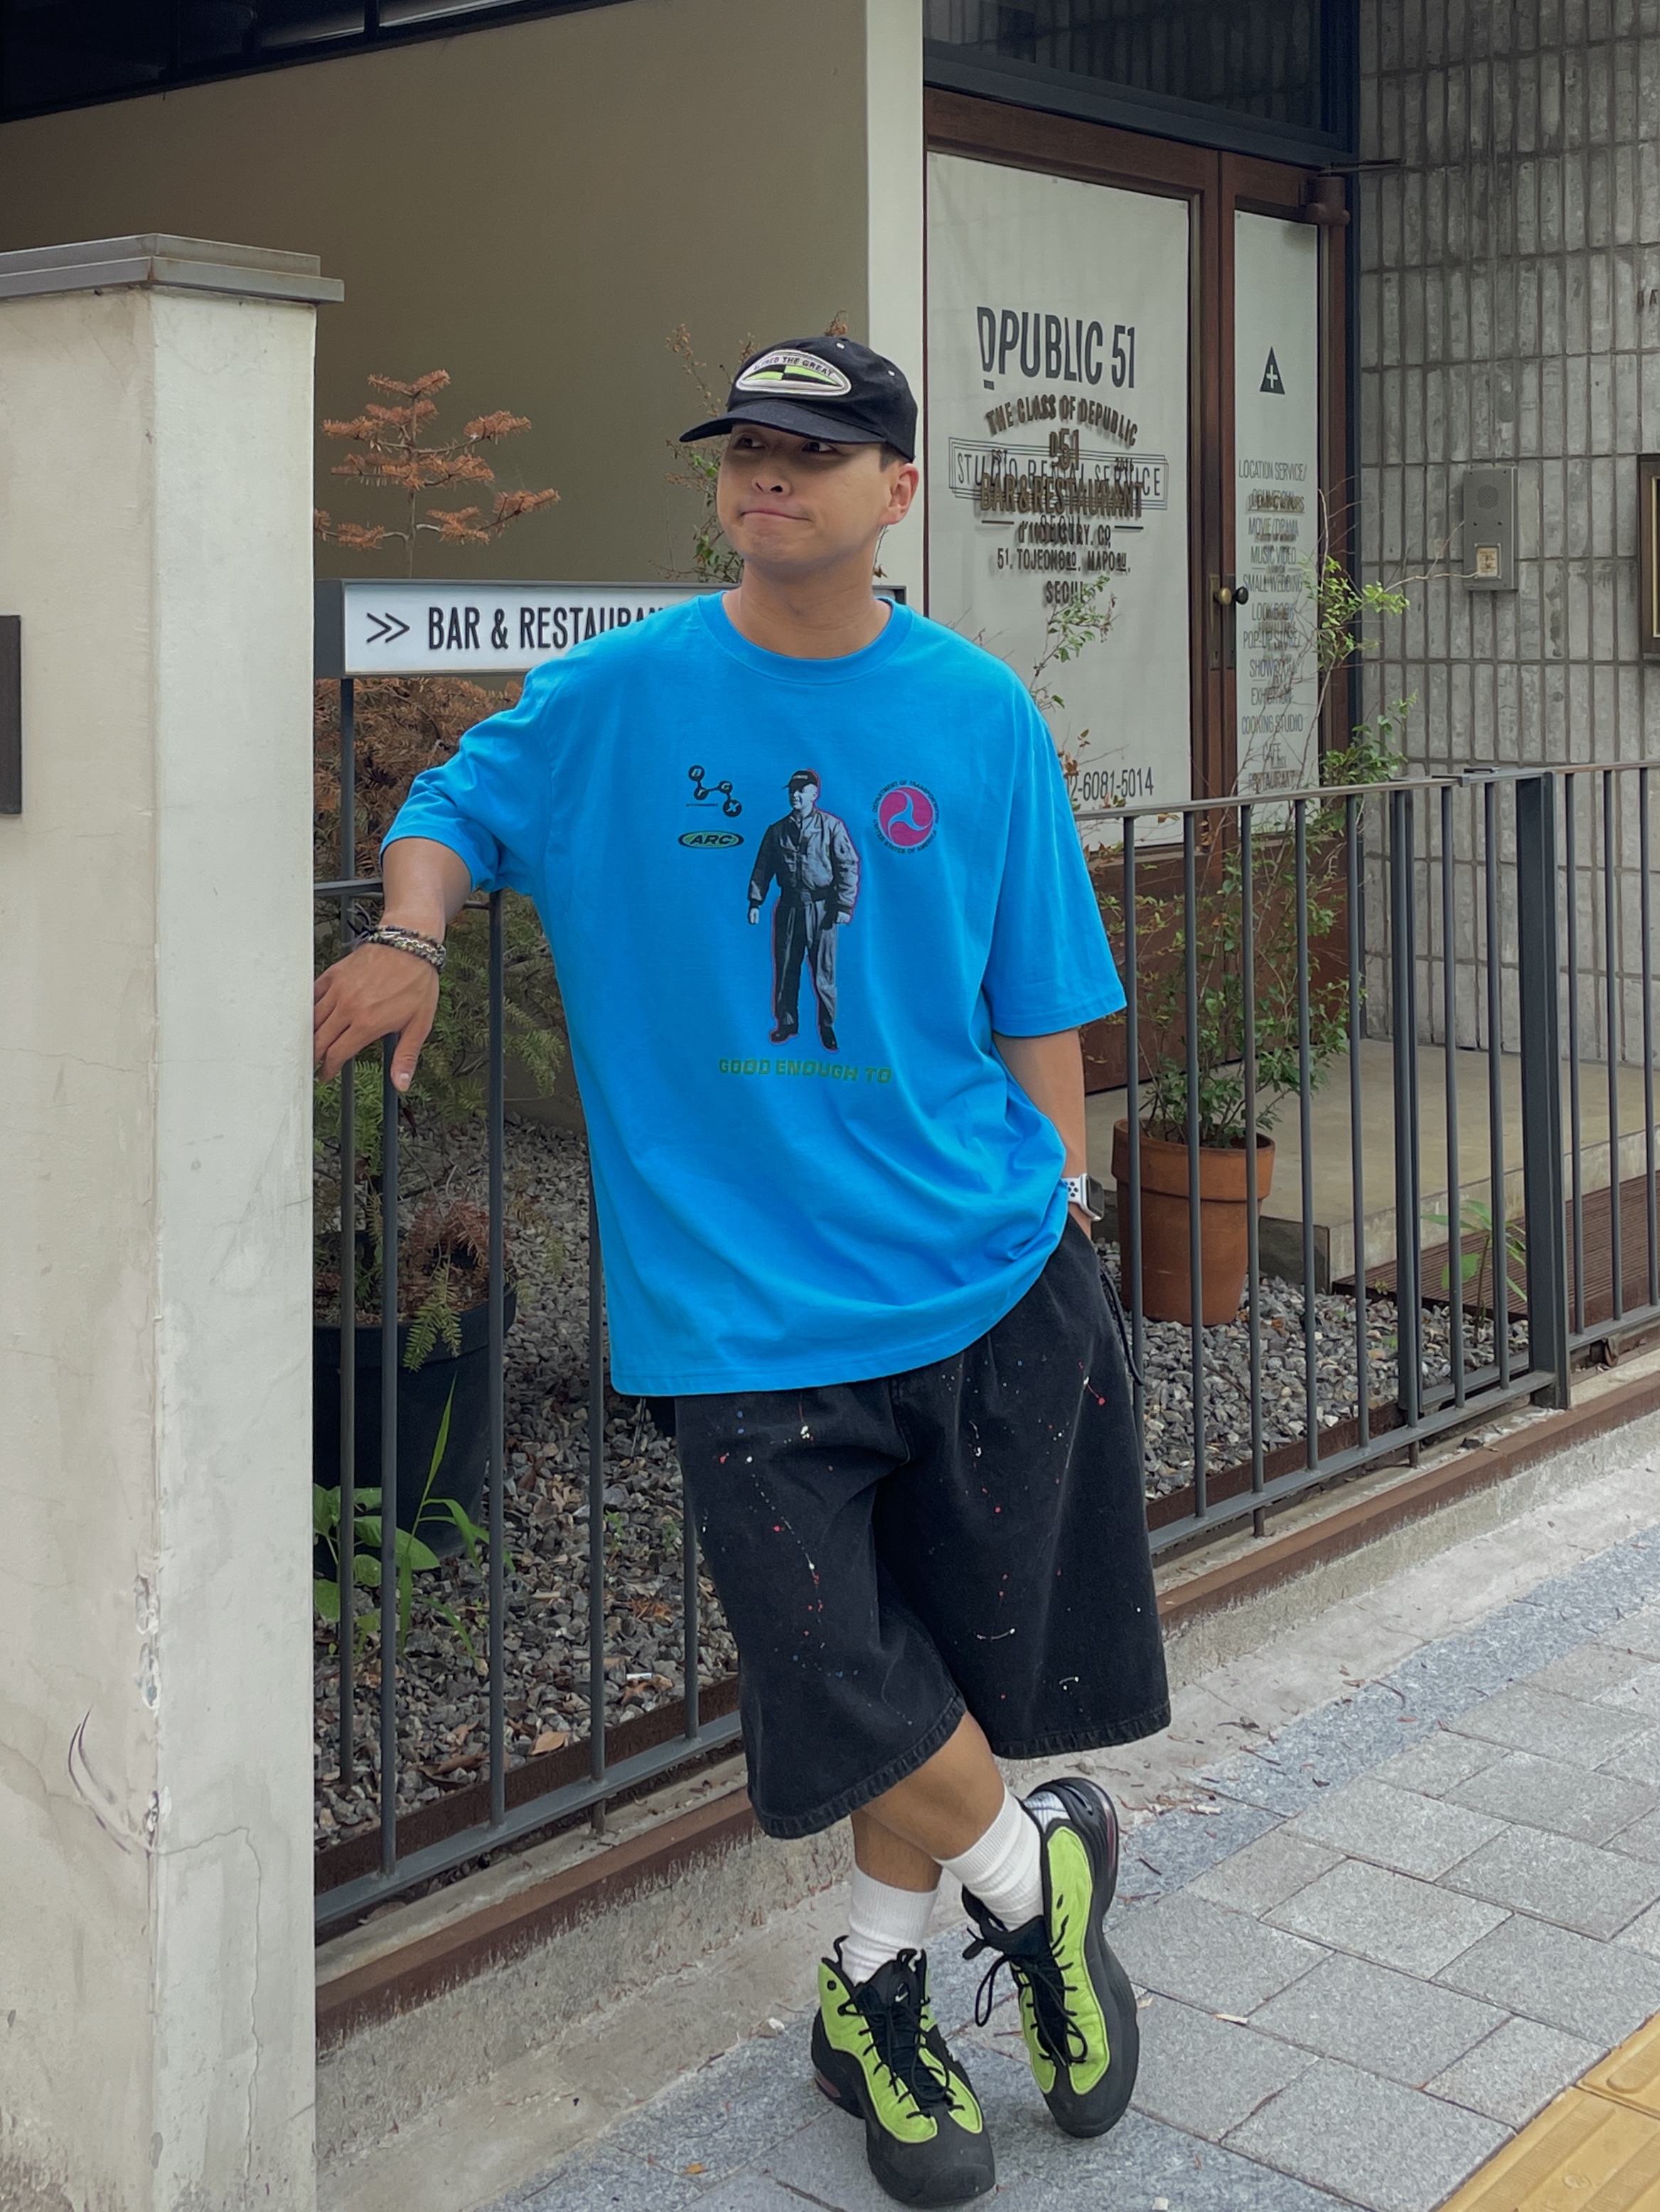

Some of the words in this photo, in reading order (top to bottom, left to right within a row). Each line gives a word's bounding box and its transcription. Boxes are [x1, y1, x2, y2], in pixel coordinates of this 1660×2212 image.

[783, 356, 800, 365] THE
[802, 360, 833, 377] GREAT
[1112, 325, 1135, 388] 51
[985, 402, 1014, 436] THE
[1017, 394, 1056, 424] CLASS
[1059, 395, 1076, 422] OF
[1078, 398, 1137, 446] DEPUBLIC
[1238, 459, 1273, 480] LOCATION
[429, 606, 481, 650] BAR
[491, 608, 509, 650] &
[520, 606, 663, 649] RESTAUR
[1242, 715, 1273, 734] COOKING
[690, 834, 733, 845] ARC
[719, 1058, 771, 1075] GOOD
[775, 1060, 858, 1081] ENOUGH
[864, 1067, 892, 1083] TO
